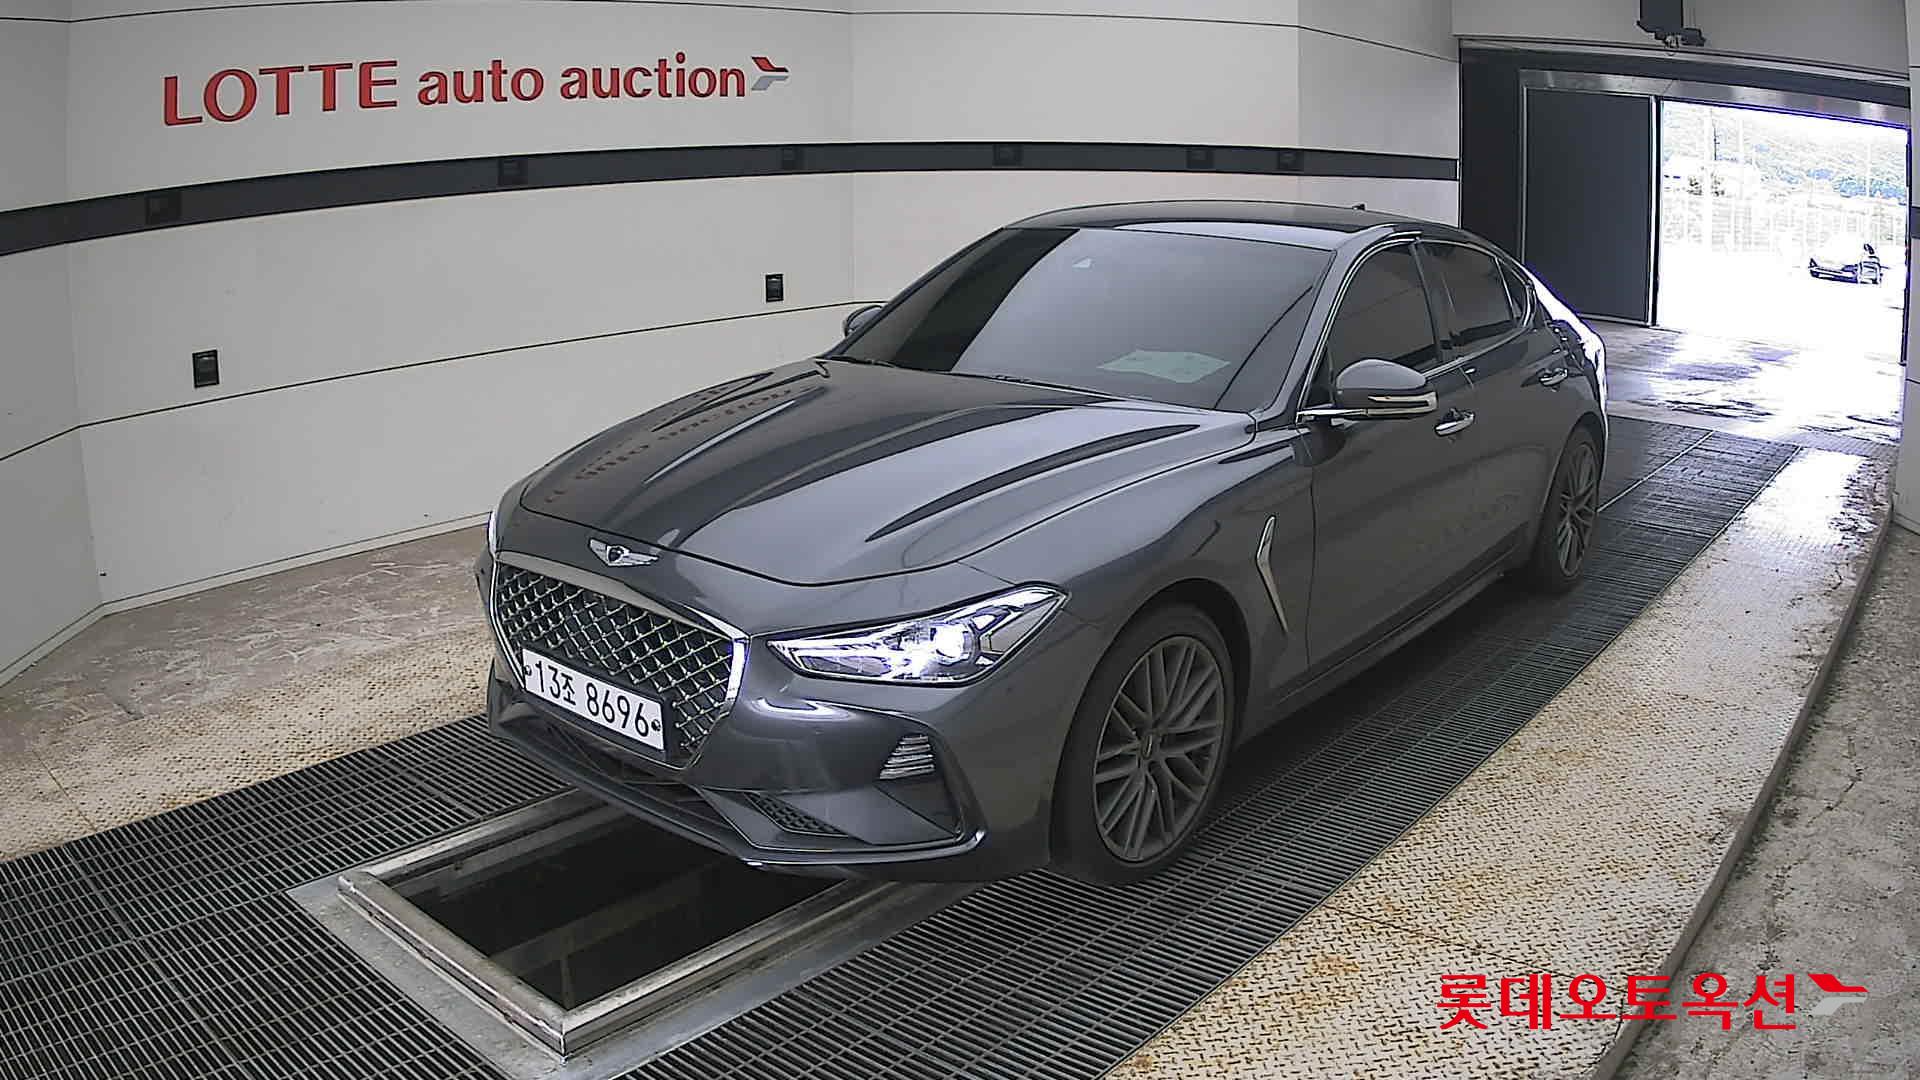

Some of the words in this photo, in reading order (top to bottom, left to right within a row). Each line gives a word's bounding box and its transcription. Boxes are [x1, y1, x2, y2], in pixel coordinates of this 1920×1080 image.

[164, 60, 398, 126] LOTTE
[417, 59, 545, 105] auto
[560, 51, 747, 99] auction
[535, 660, 577, 706] 13조
[586, 682, 650, 737] 8696
